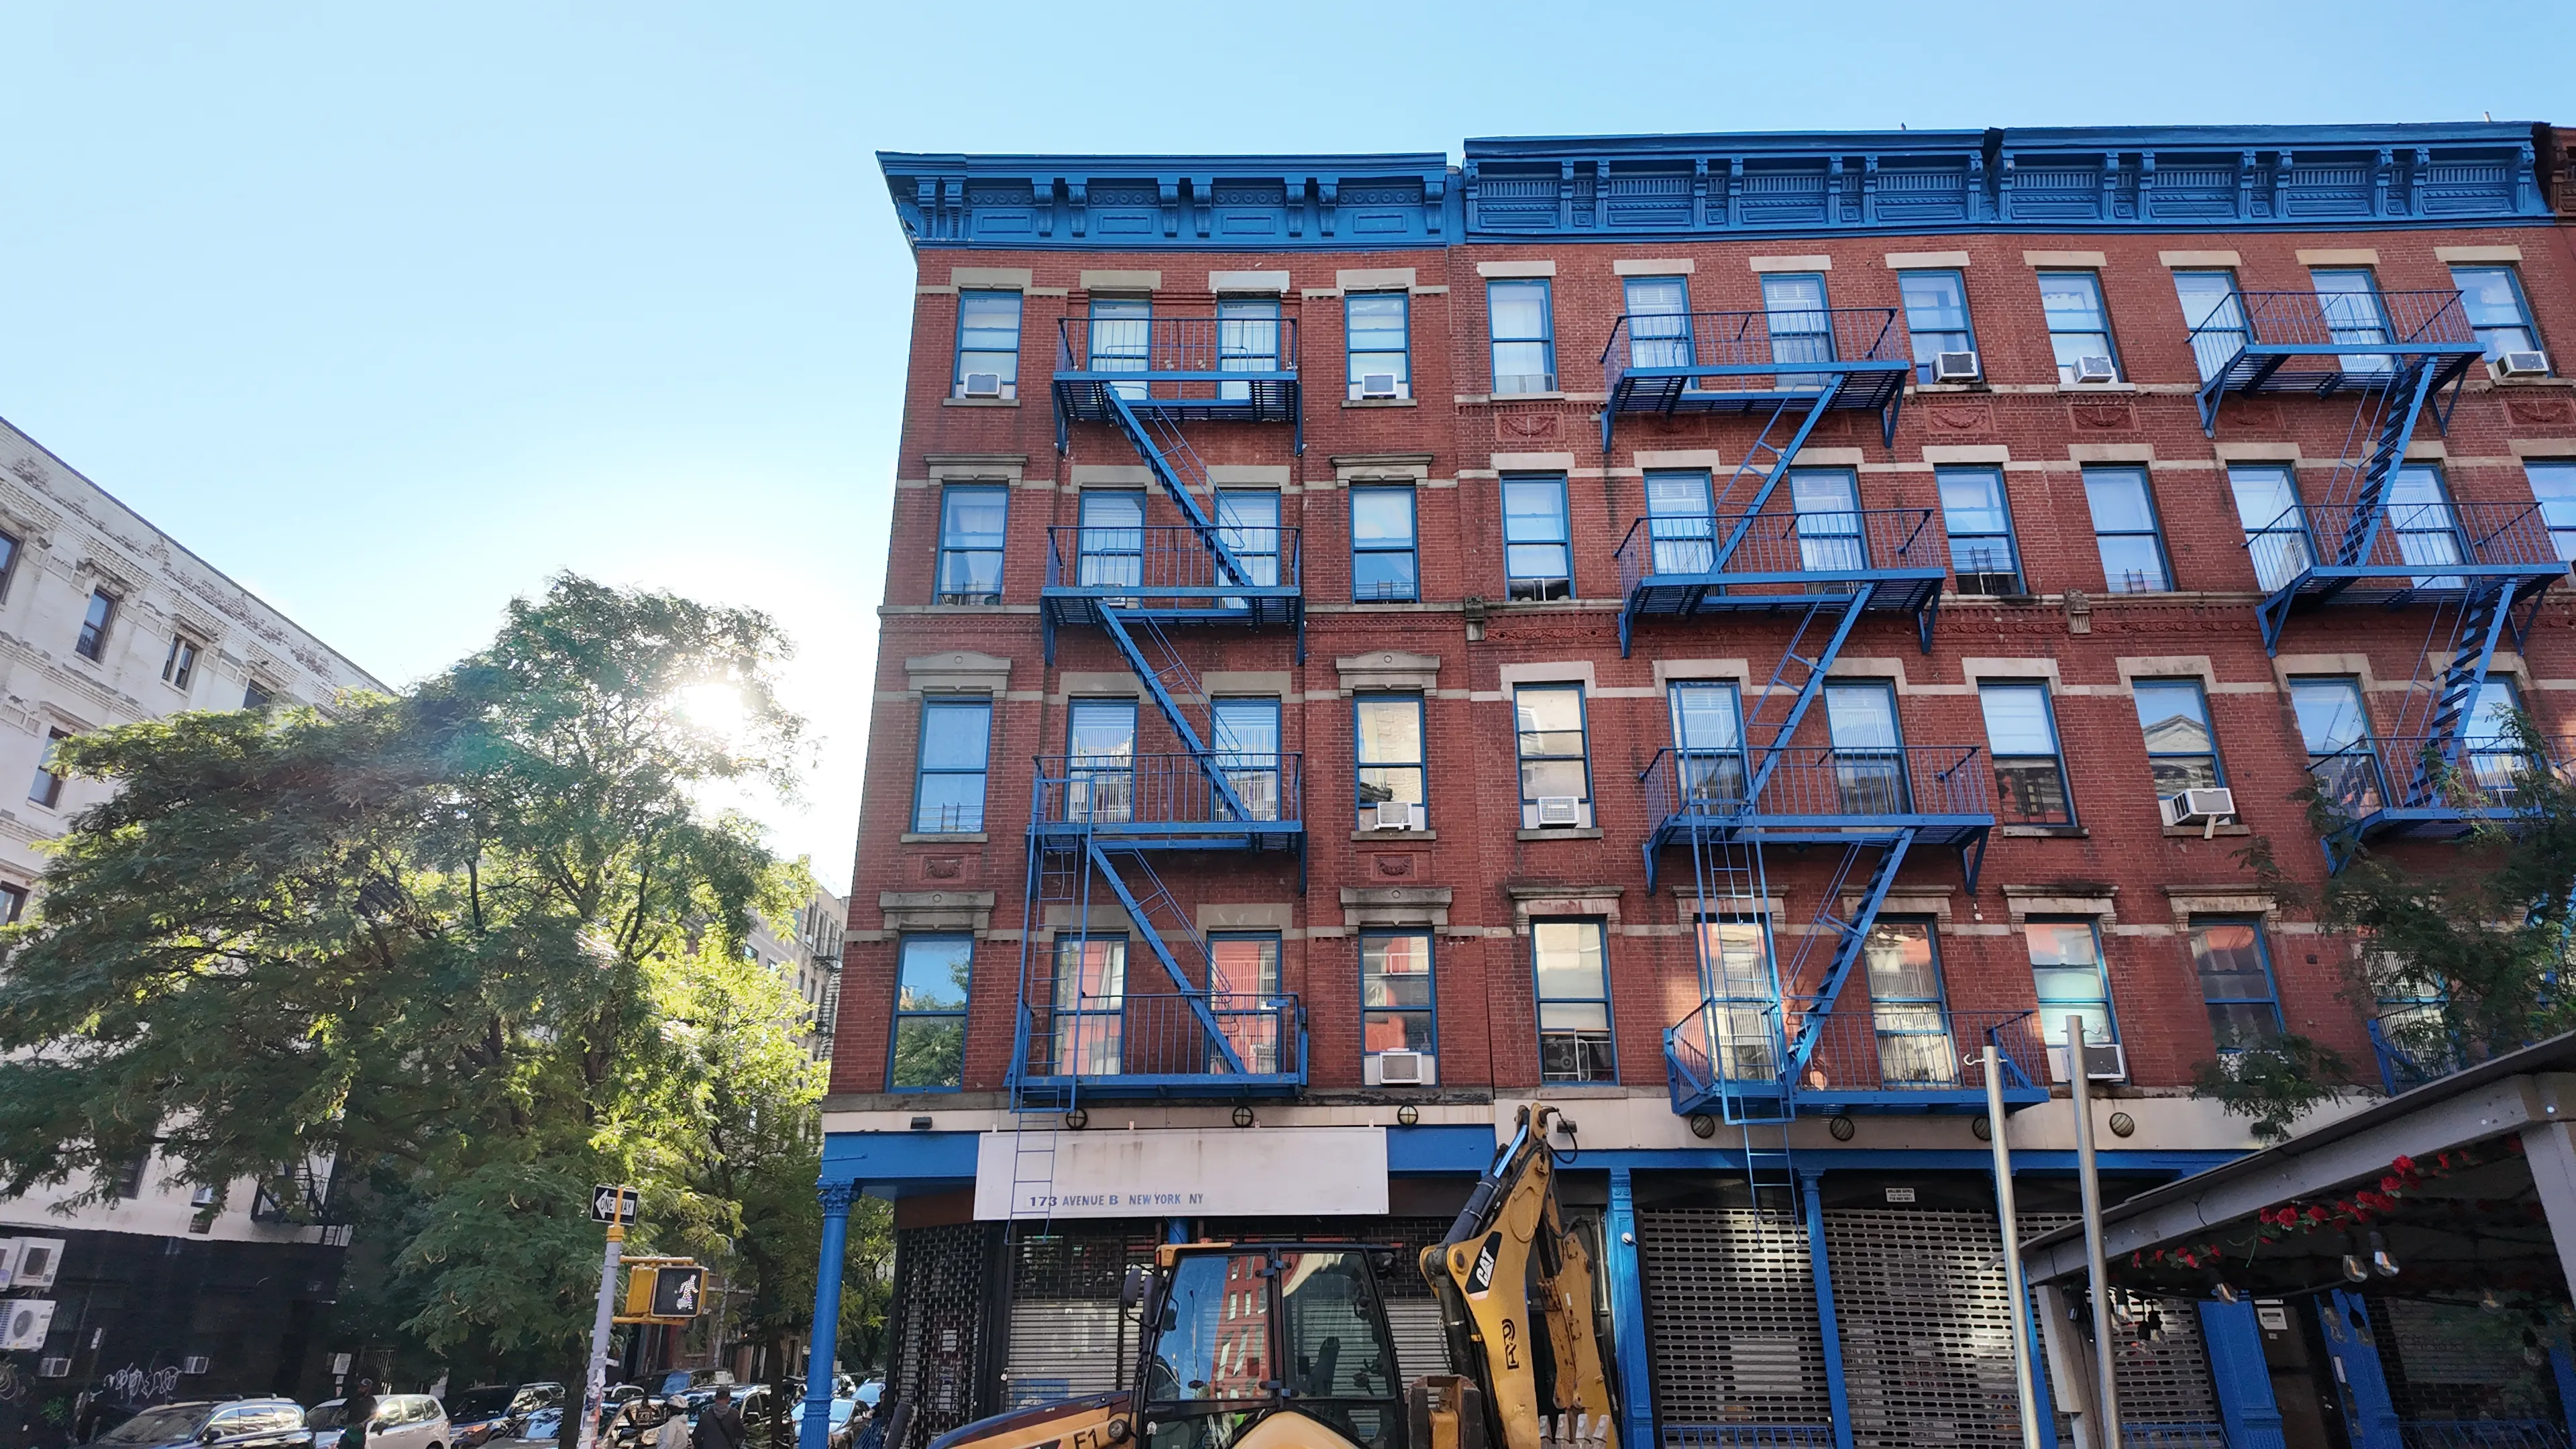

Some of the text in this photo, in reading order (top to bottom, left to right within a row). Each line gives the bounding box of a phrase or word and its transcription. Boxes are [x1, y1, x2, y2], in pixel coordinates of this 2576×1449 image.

[600, 1197, 632, 1213] ONE AY
[1030, 1193, 1203, 1207] 173 AVENUE B NEW YORK NY
[1476, 1246, 1495, 1287] CAT
[1073, 1428, 1098, 1449] F1
